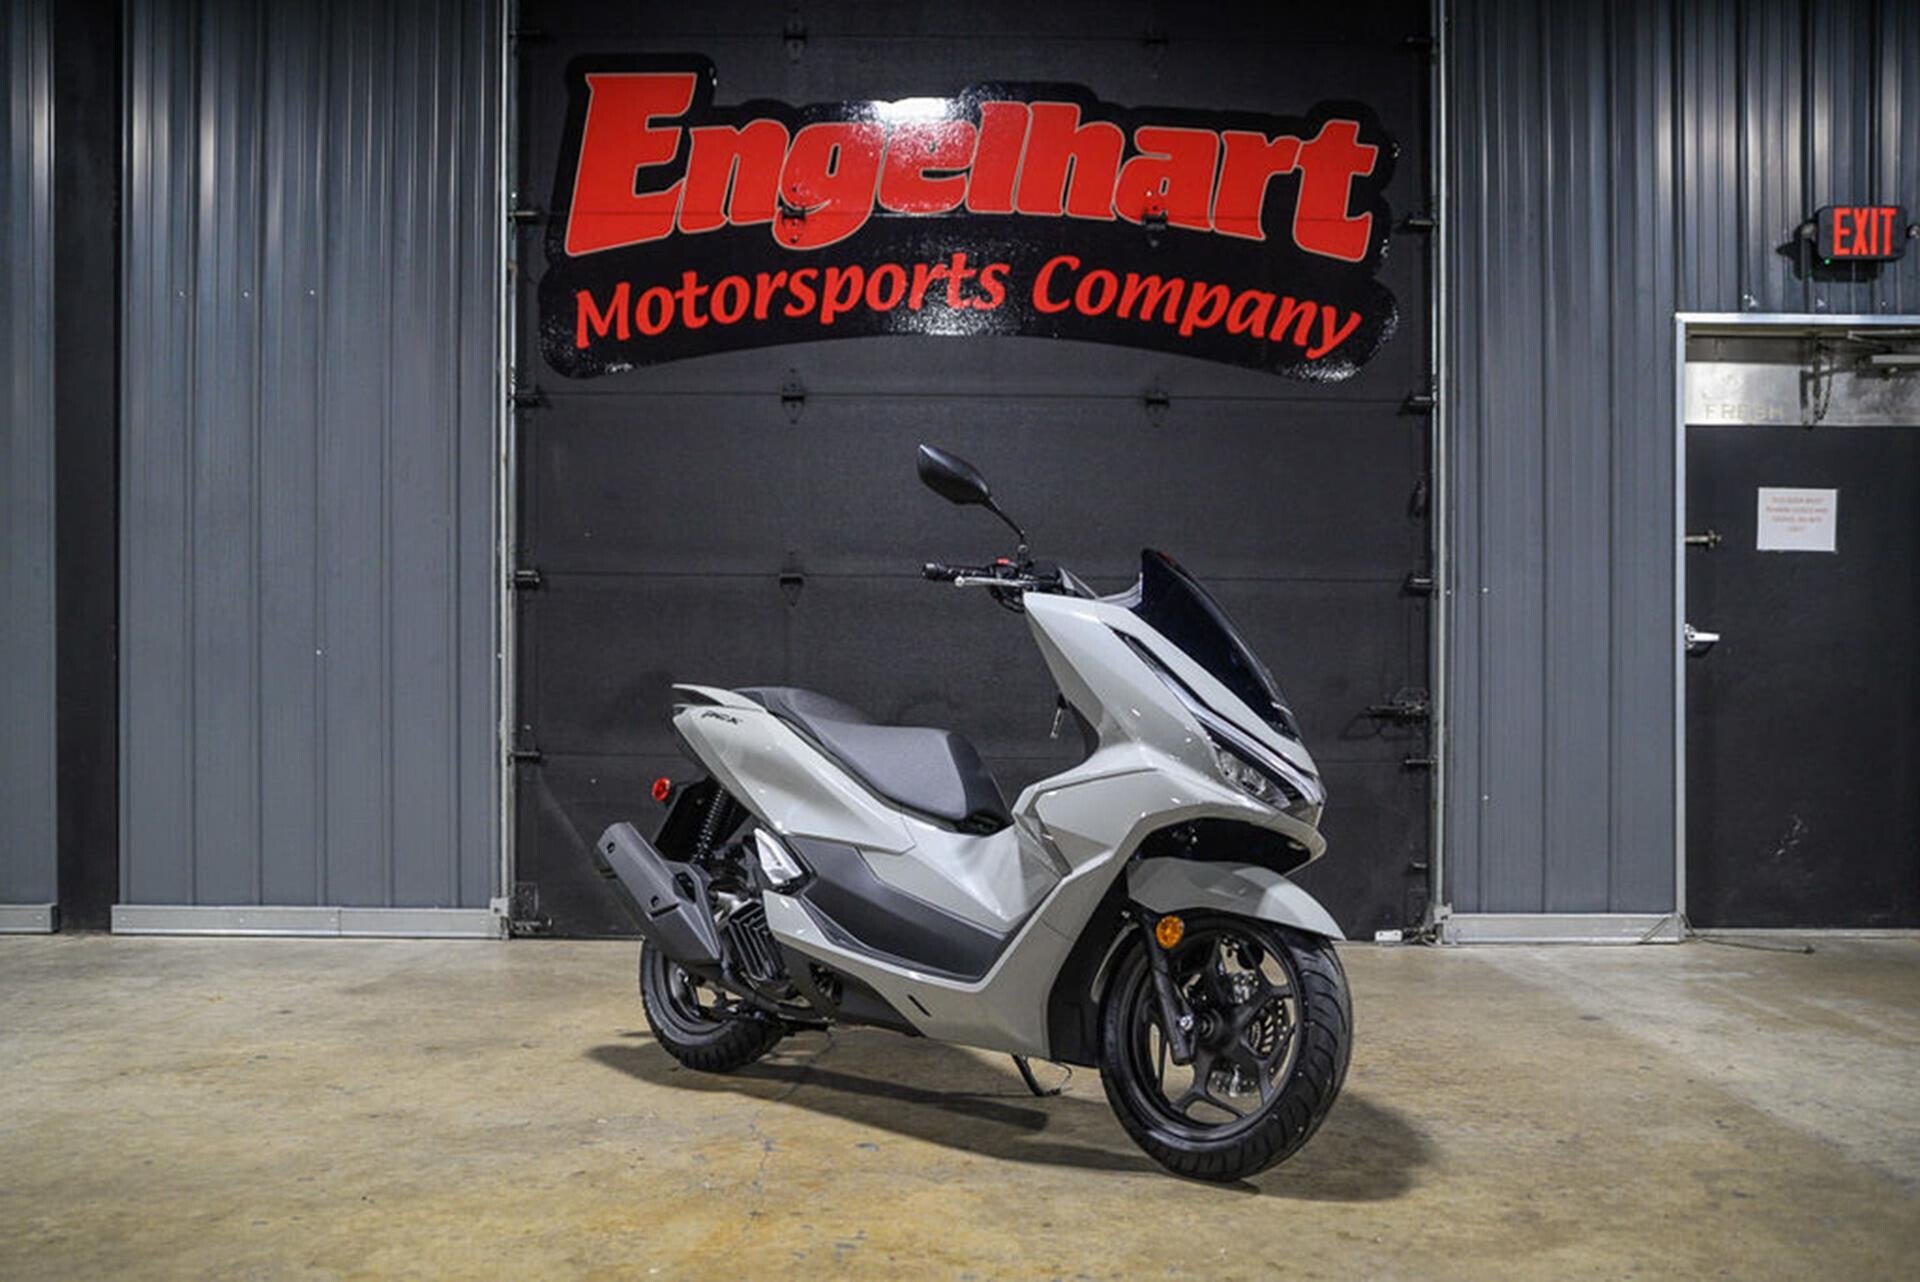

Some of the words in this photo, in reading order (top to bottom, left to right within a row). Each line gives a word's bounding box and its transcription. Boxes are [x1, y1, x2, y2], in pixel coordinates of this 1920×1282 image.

[565, 73, 1379, 262] Engelhart
[1832, 207, 1896, 256] EXIT
[575, 252, 1010, 349] Motorsports
[1032, 255, 1362, 360] Company
